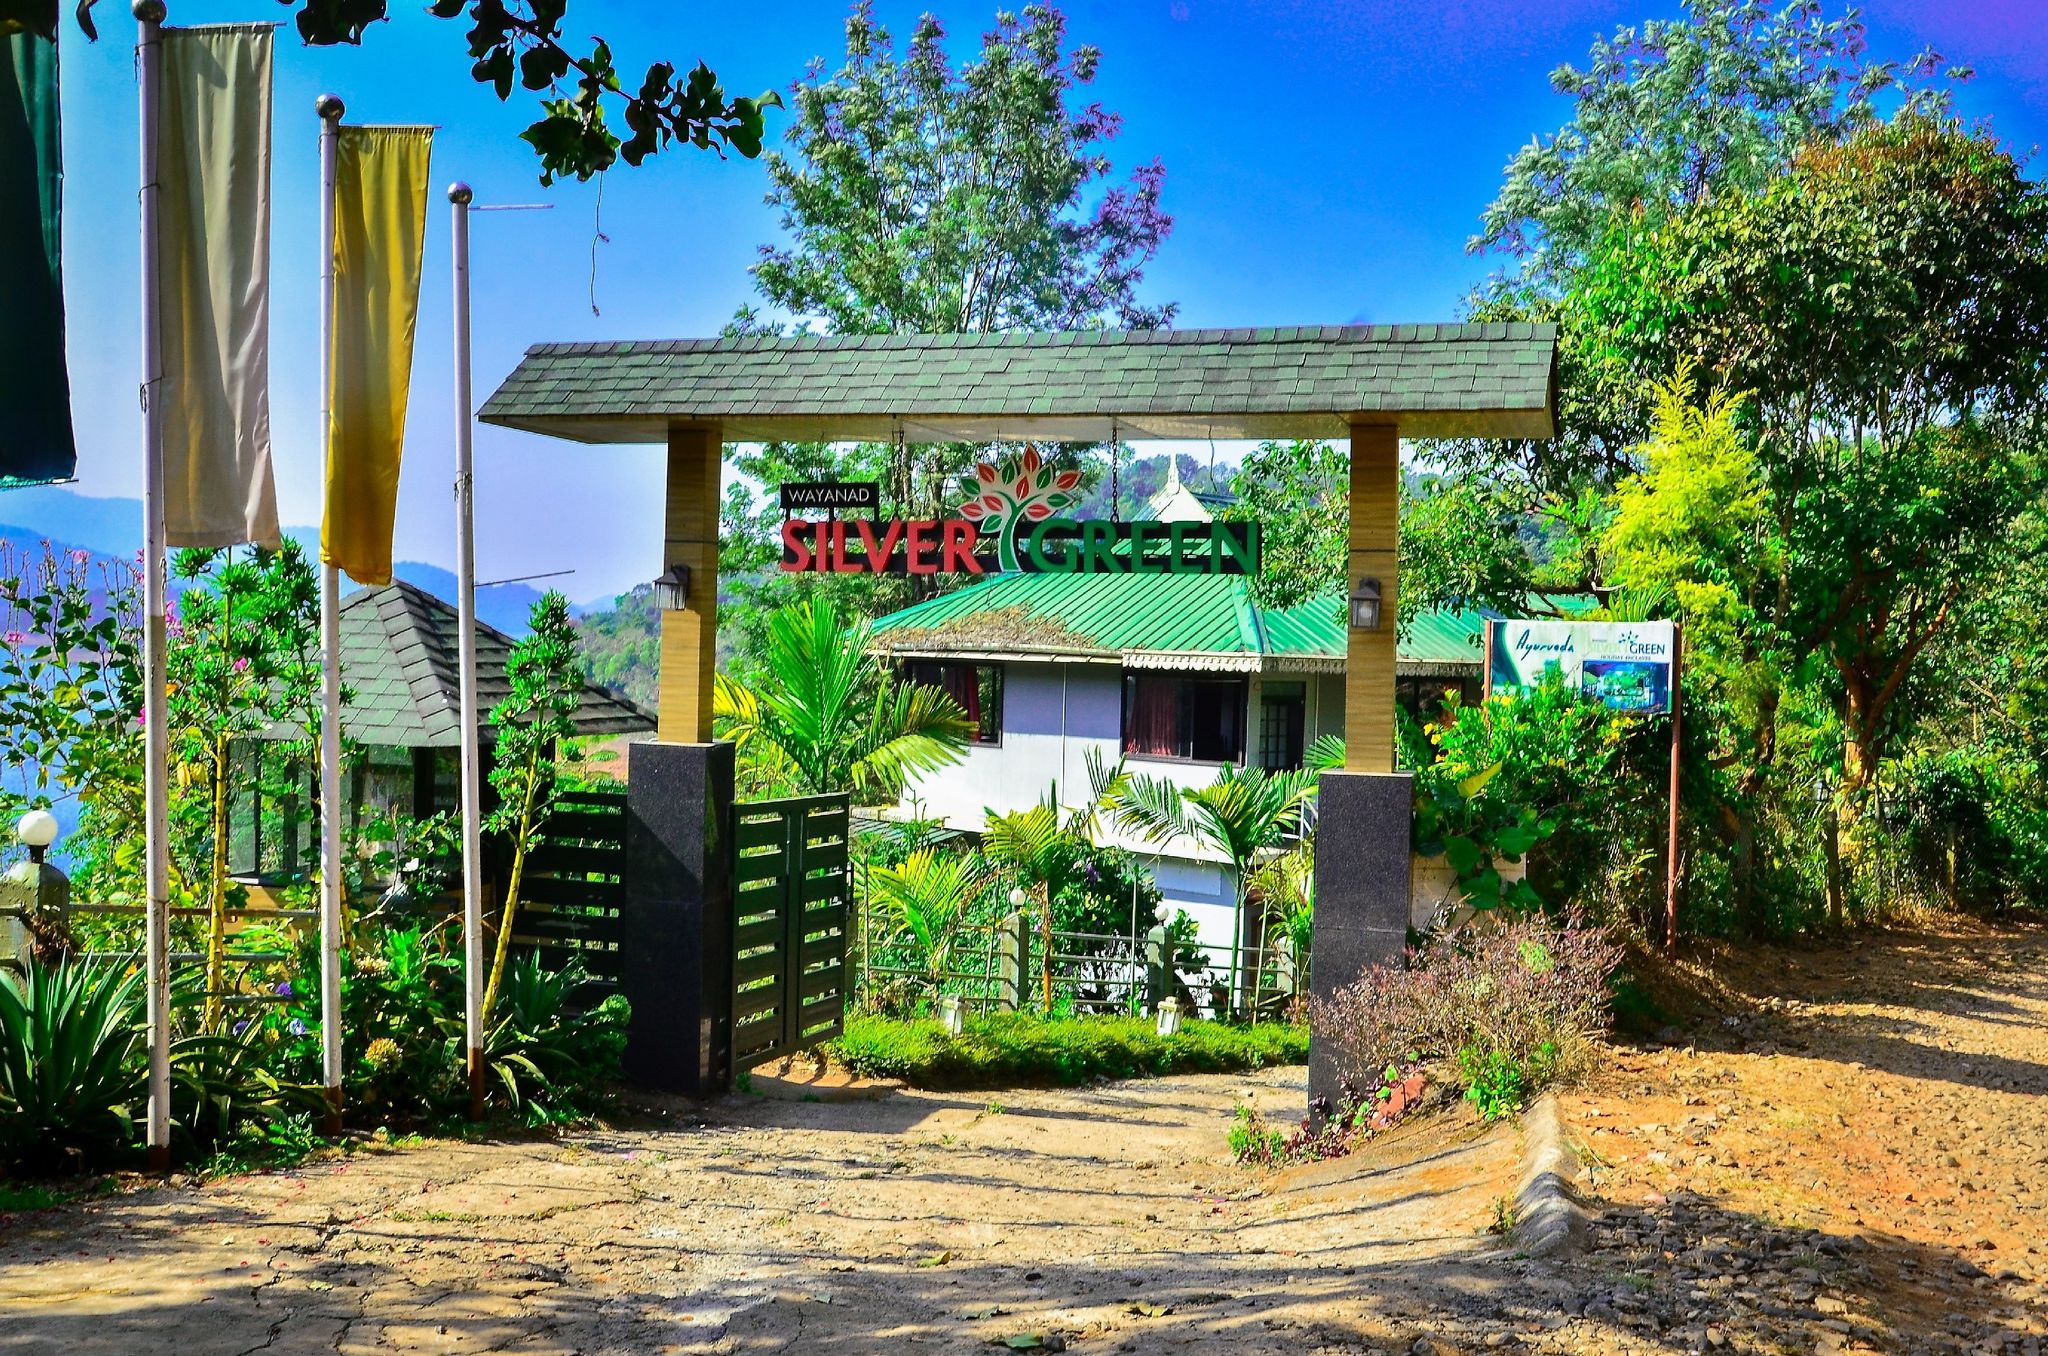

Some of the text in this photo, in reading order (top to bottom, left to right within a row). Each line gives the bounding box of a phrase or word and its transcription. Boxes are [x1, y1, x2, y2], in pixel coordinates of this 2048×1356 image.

[788, 488, 870, 502] WAYANAD
[779, 518, 1258, 575] SILVER GREEN
[1516, 629, 1574, 661] Ayurveda
[1629, 643, 1665, 655] GREEN
